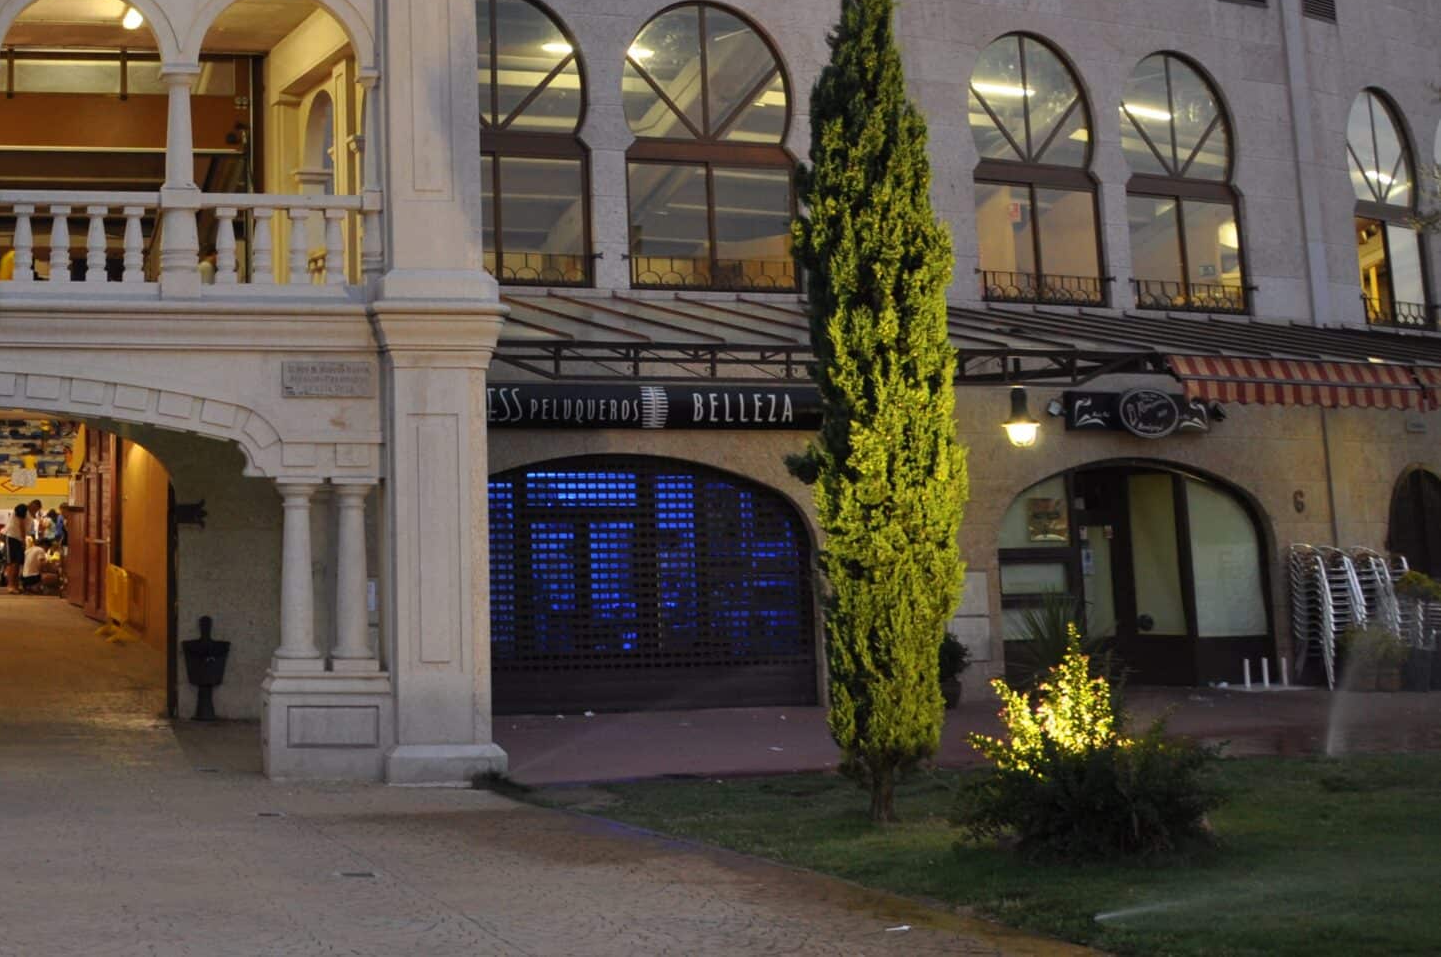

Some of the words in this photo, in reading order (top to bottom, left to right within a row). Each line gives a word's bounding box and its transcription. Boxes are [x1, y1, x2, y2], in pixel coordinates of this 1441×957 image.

[529, 397, 640, 424] PELUQUEROS
[692, 392, 794, 423] BELLEZA
[1292, 489, 1305, 514] 6
